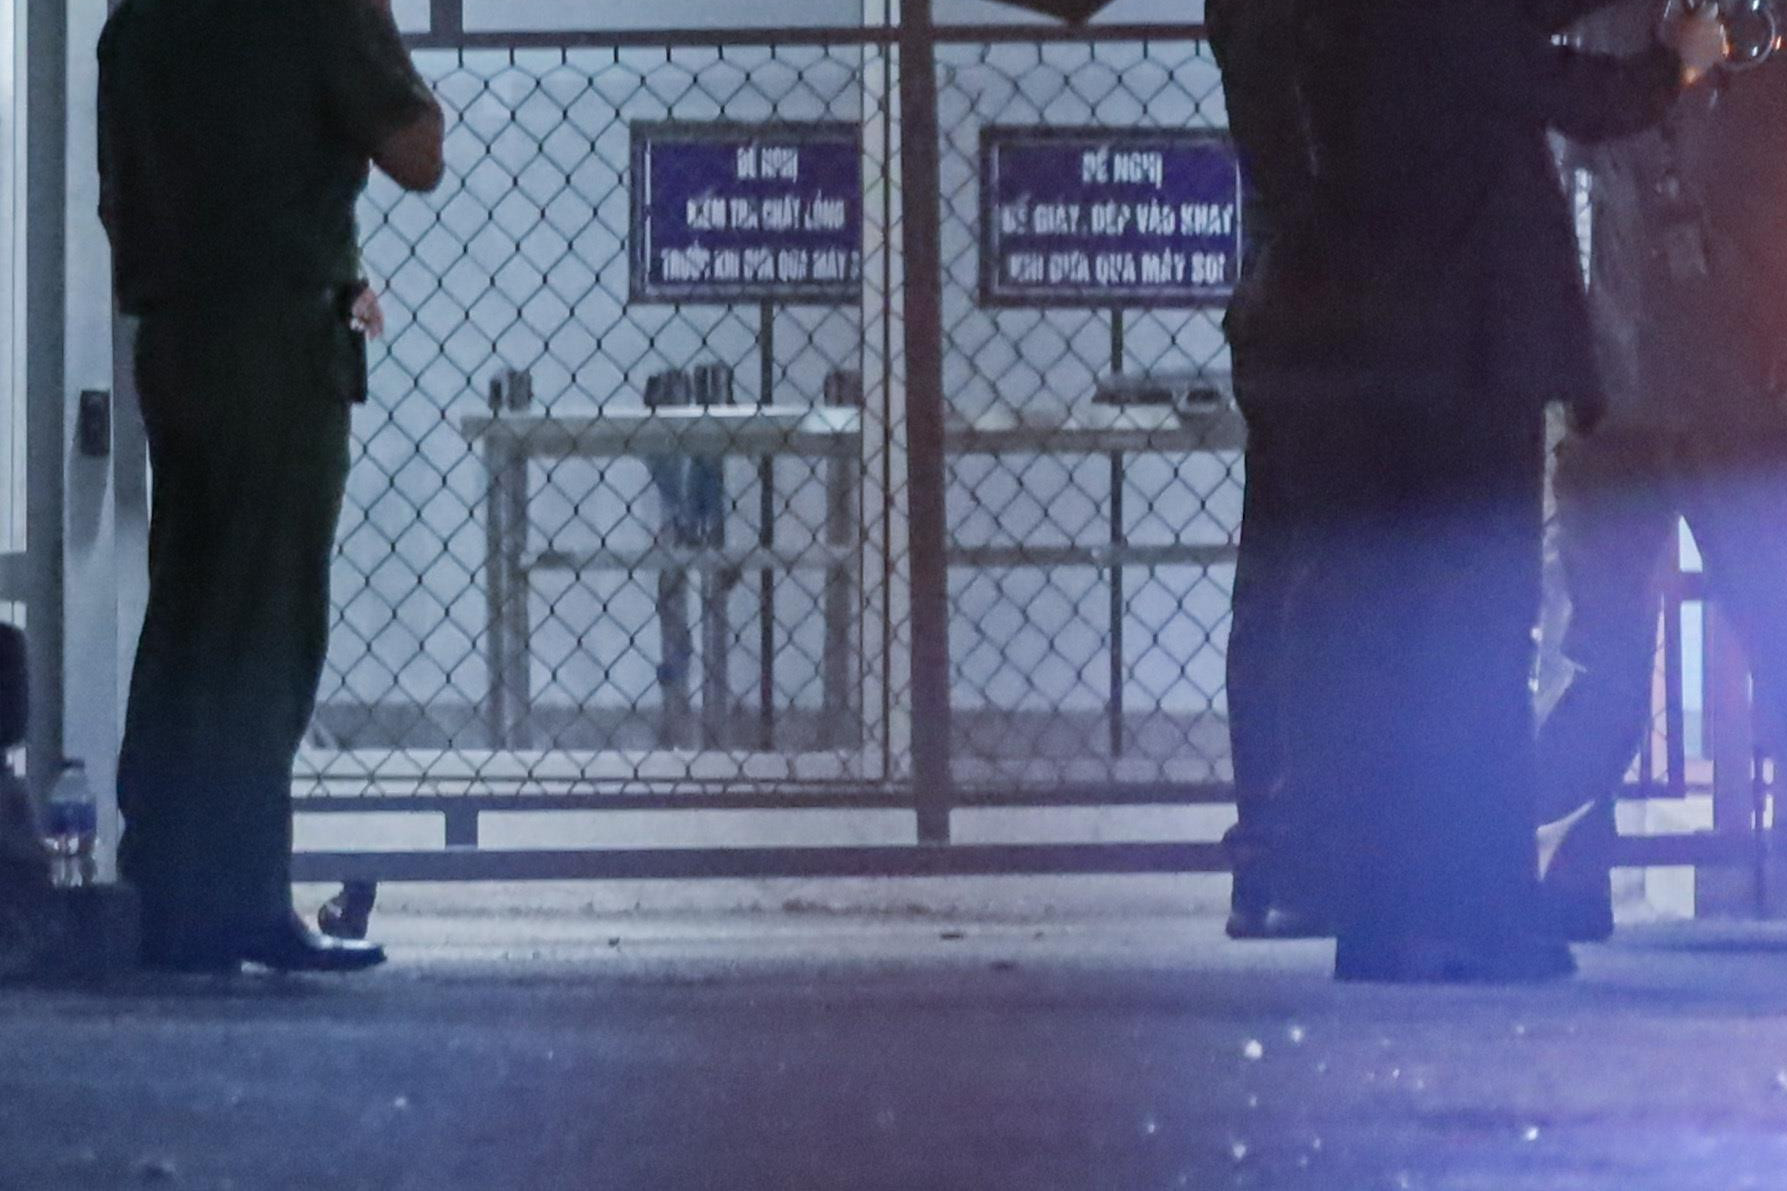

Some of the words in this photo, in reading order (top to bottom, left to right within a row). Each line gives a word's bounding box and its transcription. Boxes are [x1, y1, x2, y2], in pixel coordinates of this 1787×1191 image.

[1180, 203, 1234, 236] KHAY
[1095, 253, 1136, 285] QUA
[1142, 245, 1186, 283] MÁY
[1191, 251, 1226, 284] SOI
